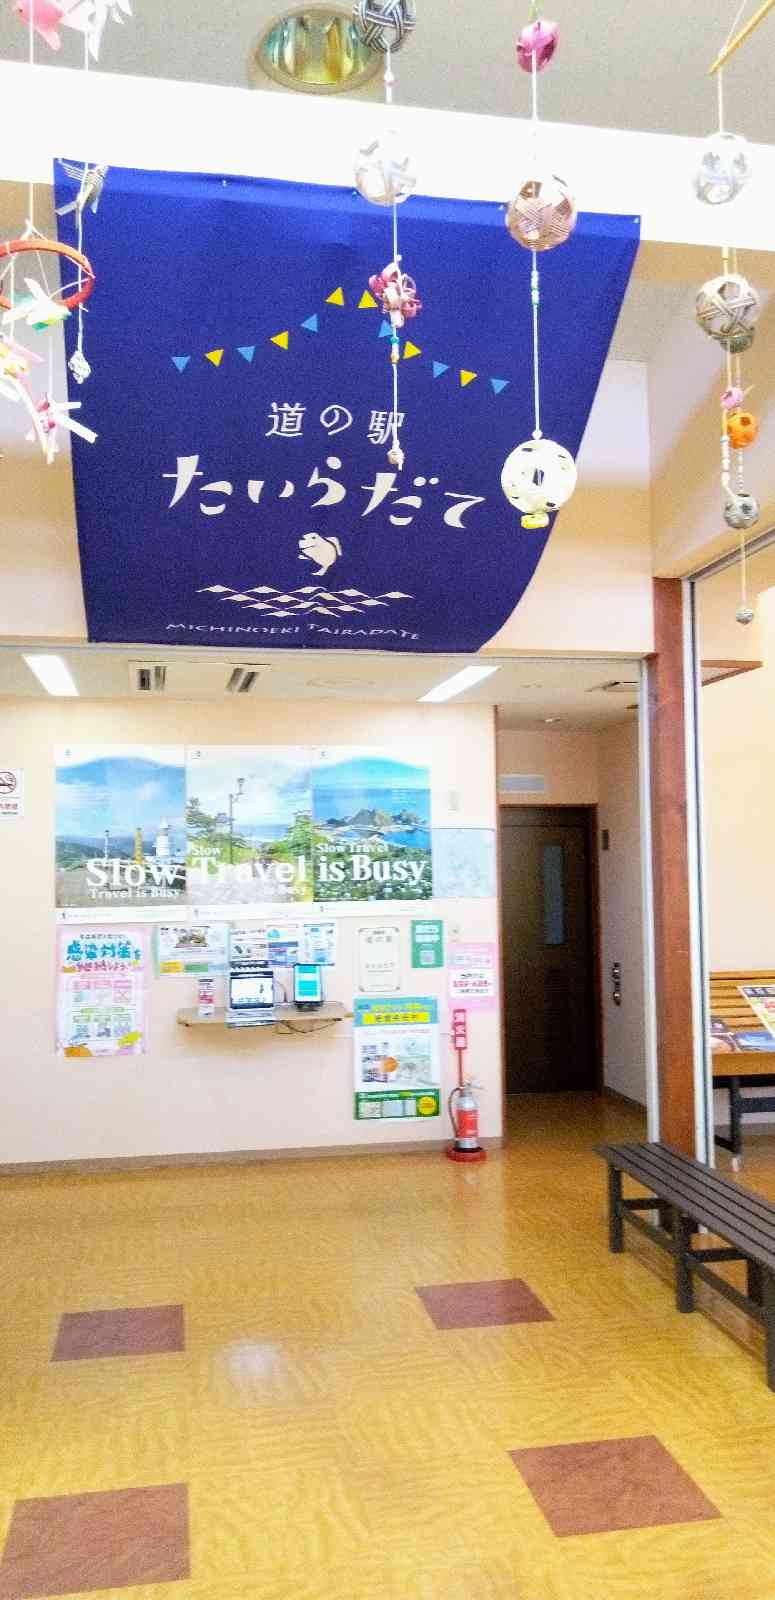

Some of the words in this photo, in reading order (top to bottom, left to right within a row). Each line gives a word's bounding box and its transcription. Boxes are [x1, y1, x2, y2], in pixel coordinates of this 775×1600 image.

[265, 402, 407, 445] 道の駅
[163, 455, 486, 528] たいらだて
[166, 623, 301, 634] MICHINOEKI
[307, 622, 420, 641] TAIRADATE
[86, 858, 183, 887] Slow
[192, 855, 307, 883] Travel
[319, 856, 344, 882] is
[351, 854, 427, 885] Busy
